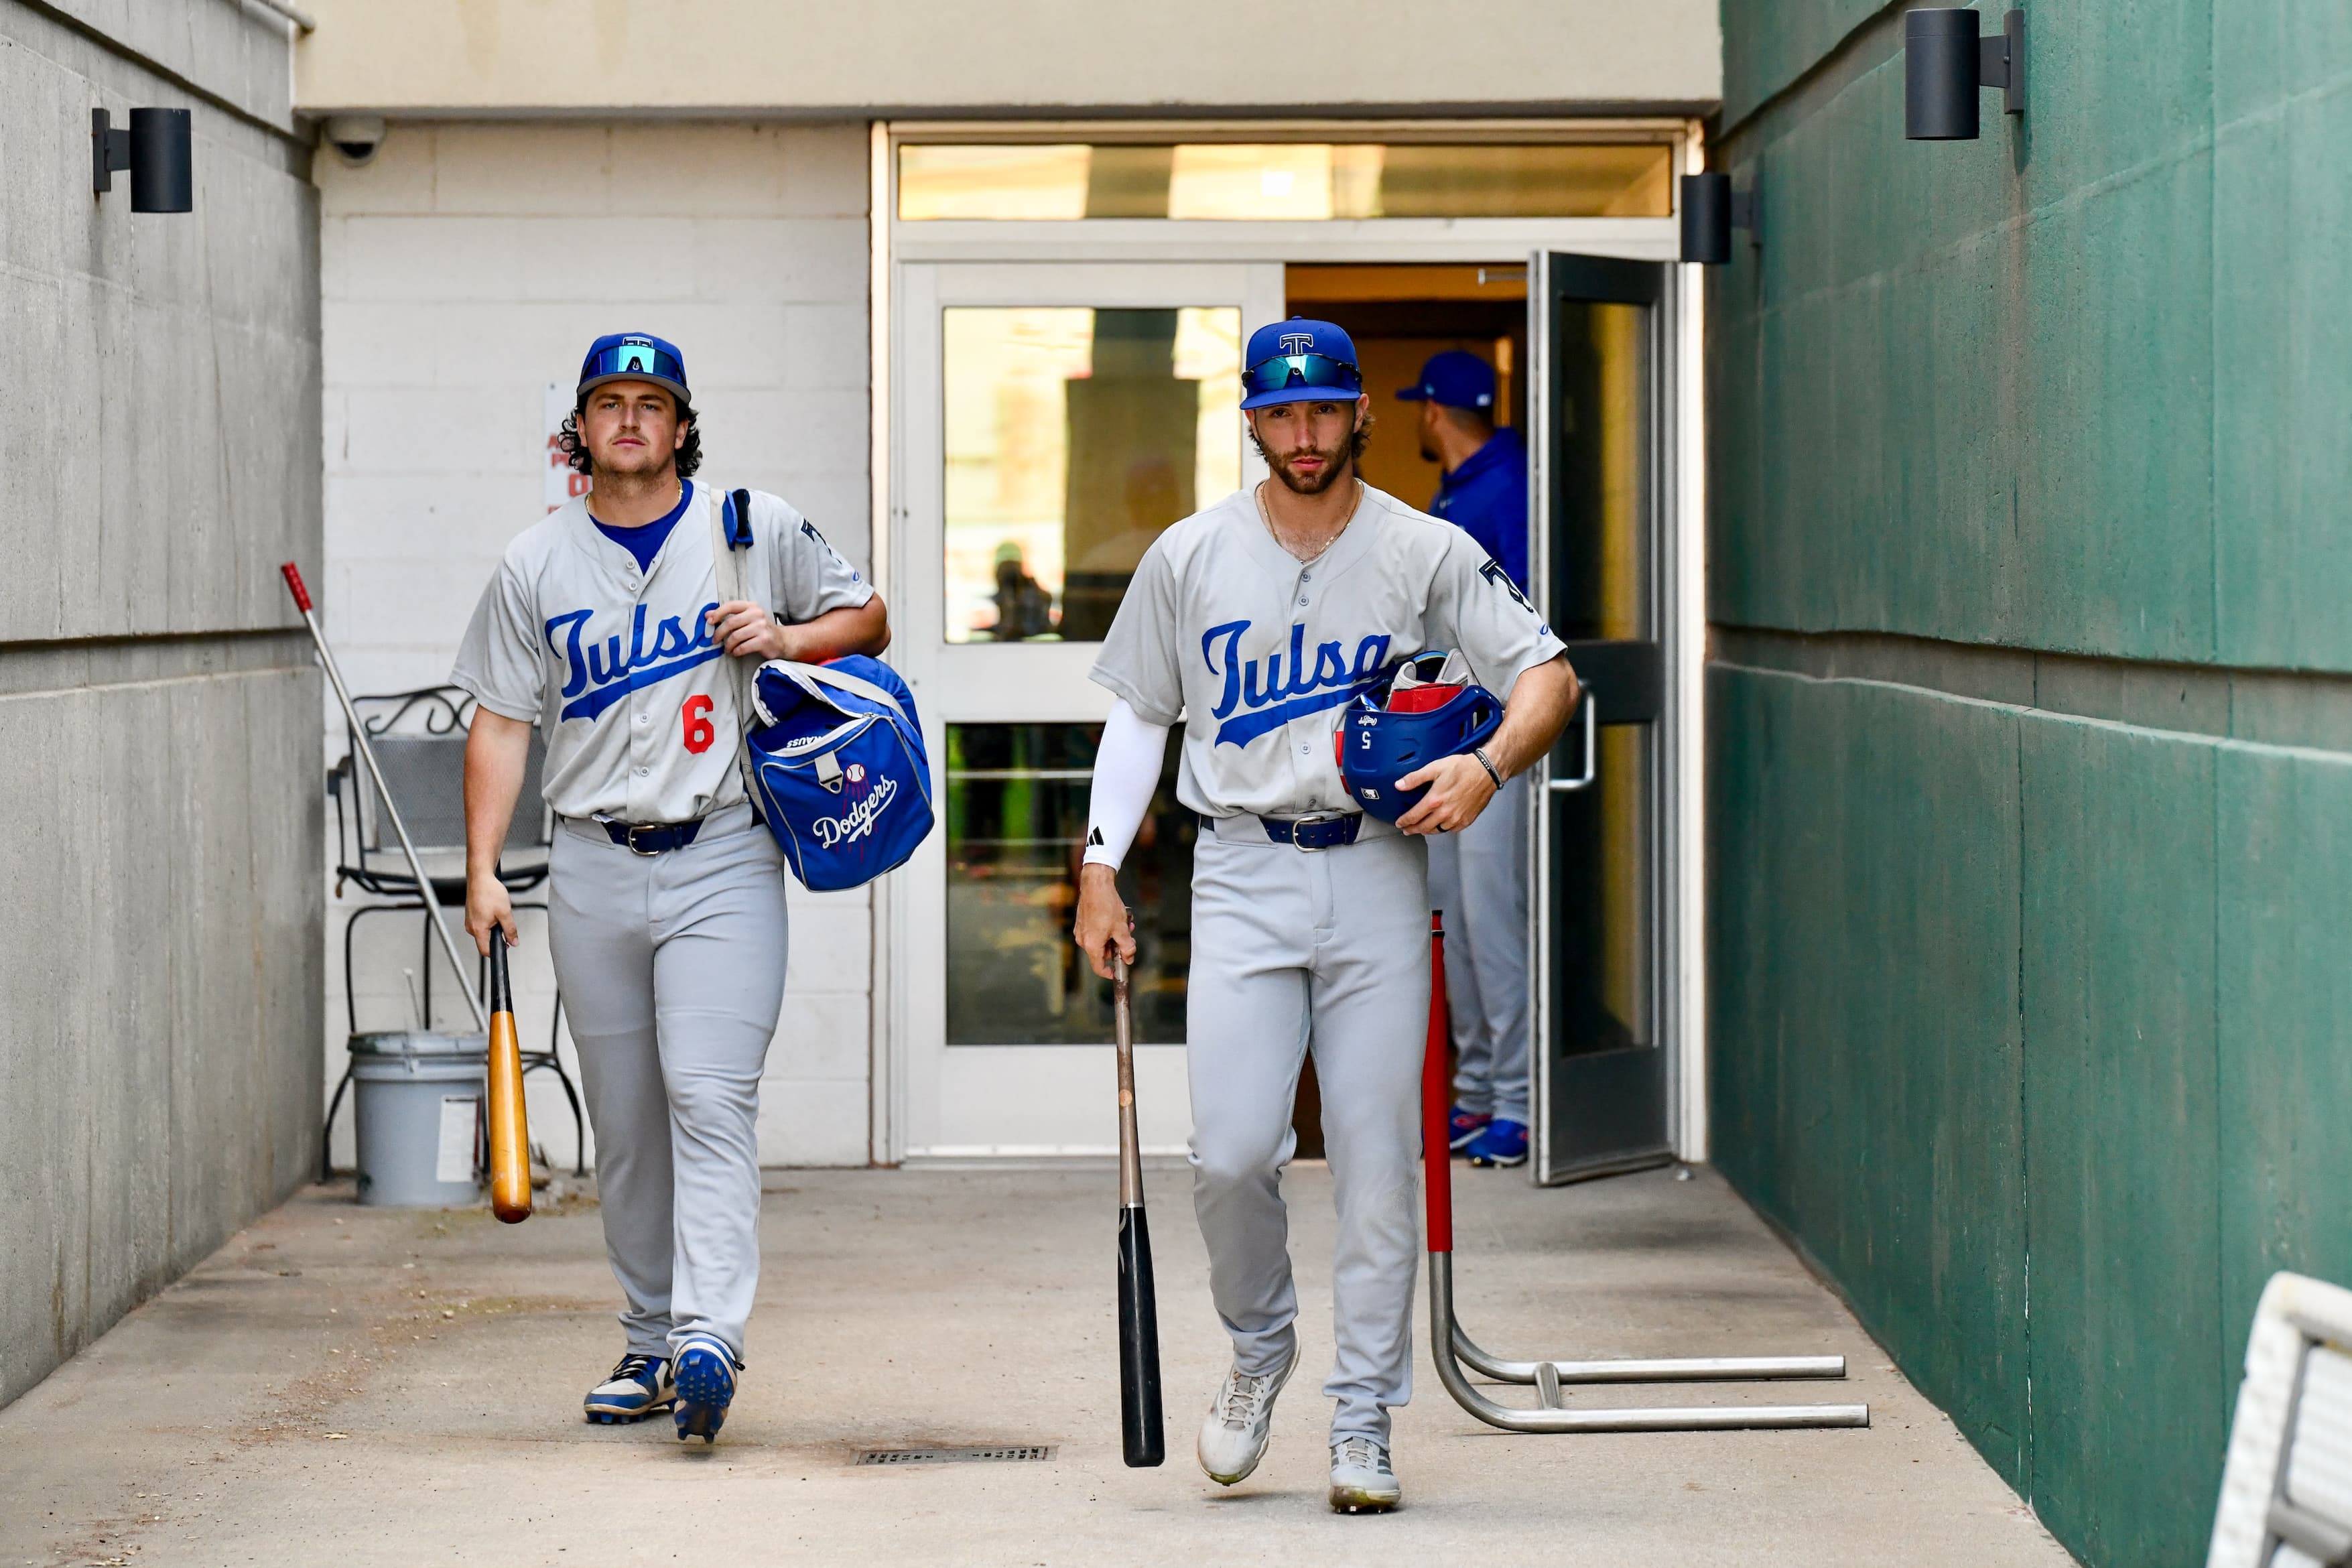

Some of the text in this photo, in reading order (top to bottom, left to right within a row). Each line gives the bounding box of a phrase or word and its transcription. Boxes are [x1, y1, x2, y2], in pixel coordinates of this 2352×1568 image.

[1201, 620, 1391, 720] Tulsa
[681, 694, 715, 755] 6
[1362, 731, 1371, 749] 5
[812, 774, 897, 849] Dodgers
